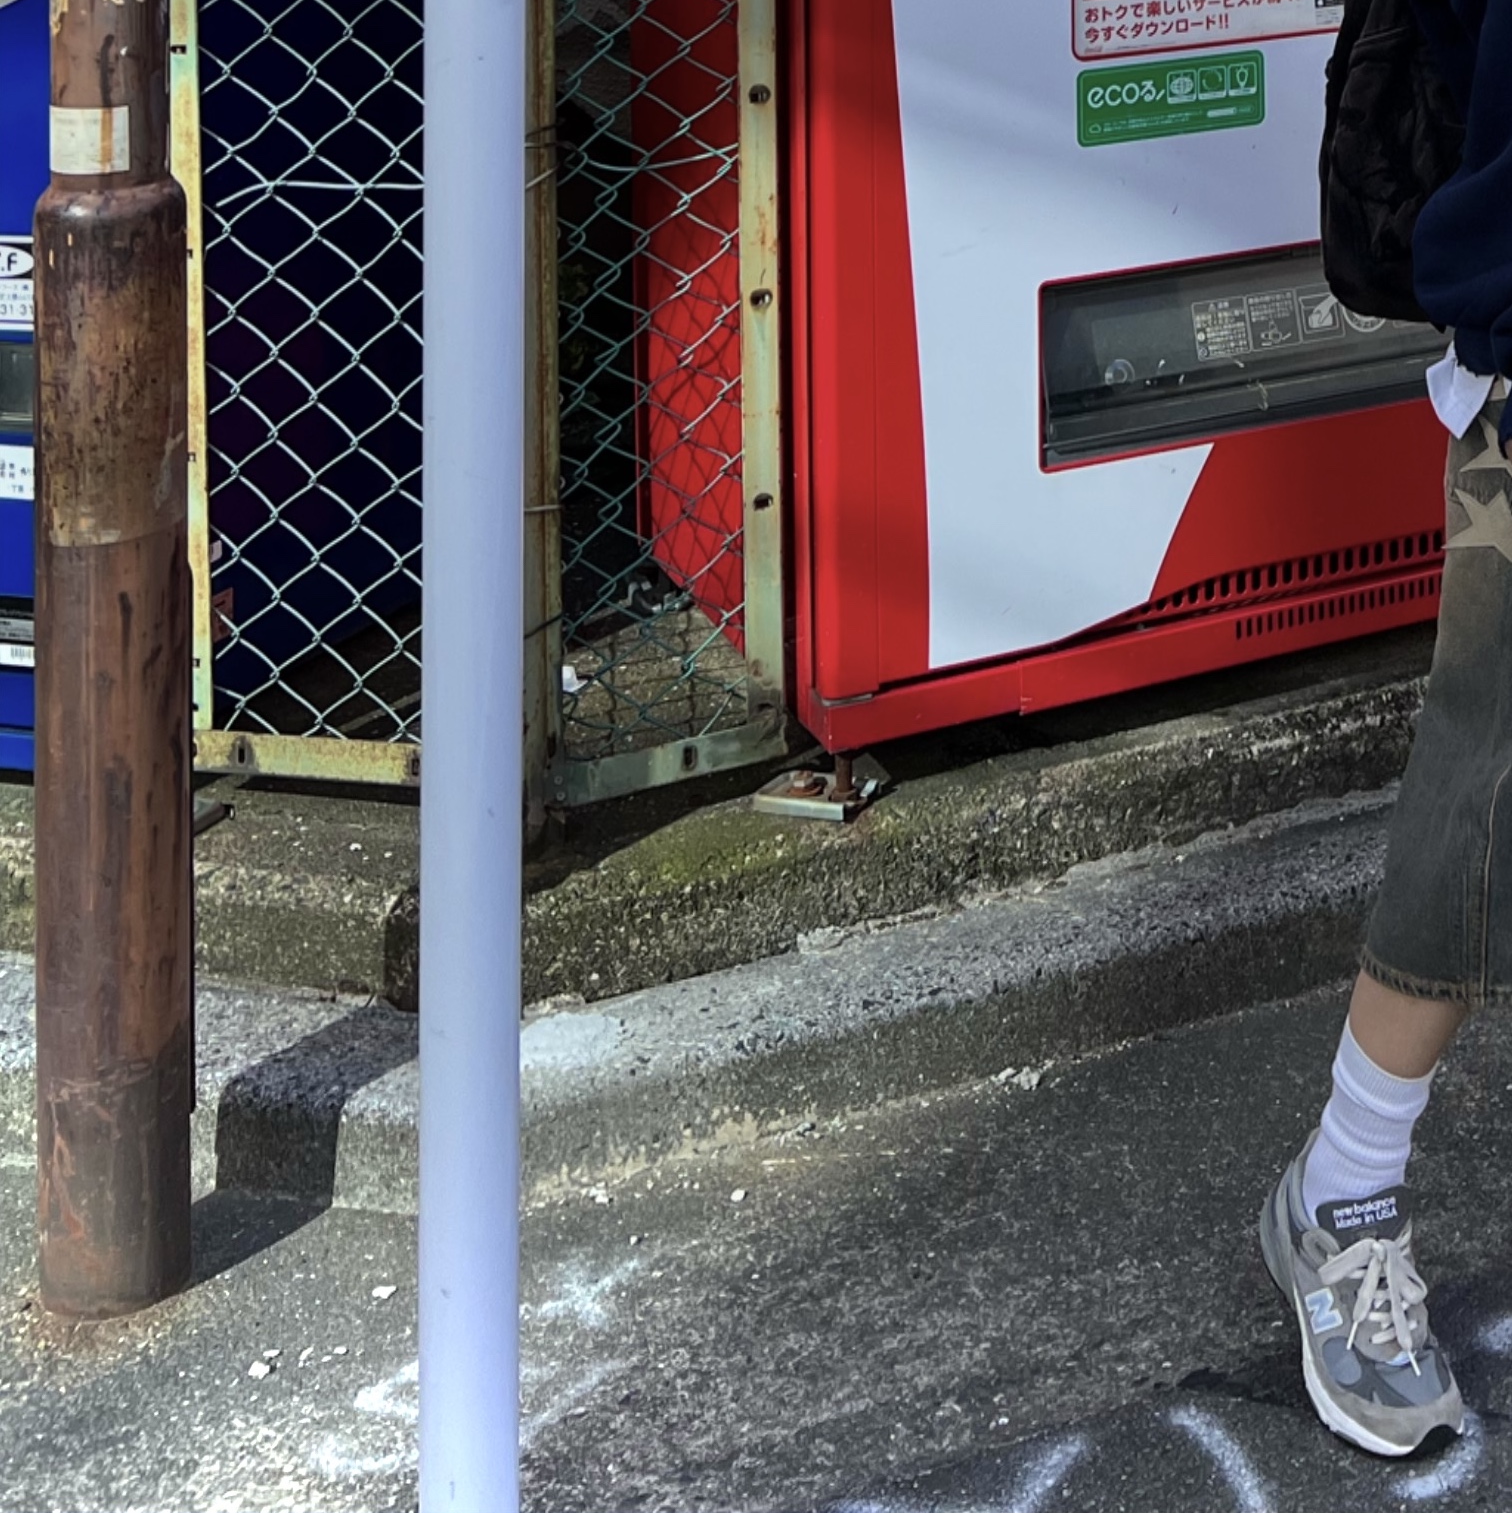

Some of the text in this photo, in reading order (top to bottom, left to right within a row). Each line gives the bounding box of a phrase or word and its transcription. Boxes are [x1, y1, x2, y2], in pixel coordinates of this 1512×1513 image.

[1084, 13, 1230, 44] 今すぐダウンロード!!
[1333, 1194, 1397, 1219] new balance
[1335, 1205, 1398, 1230] Made in USA
